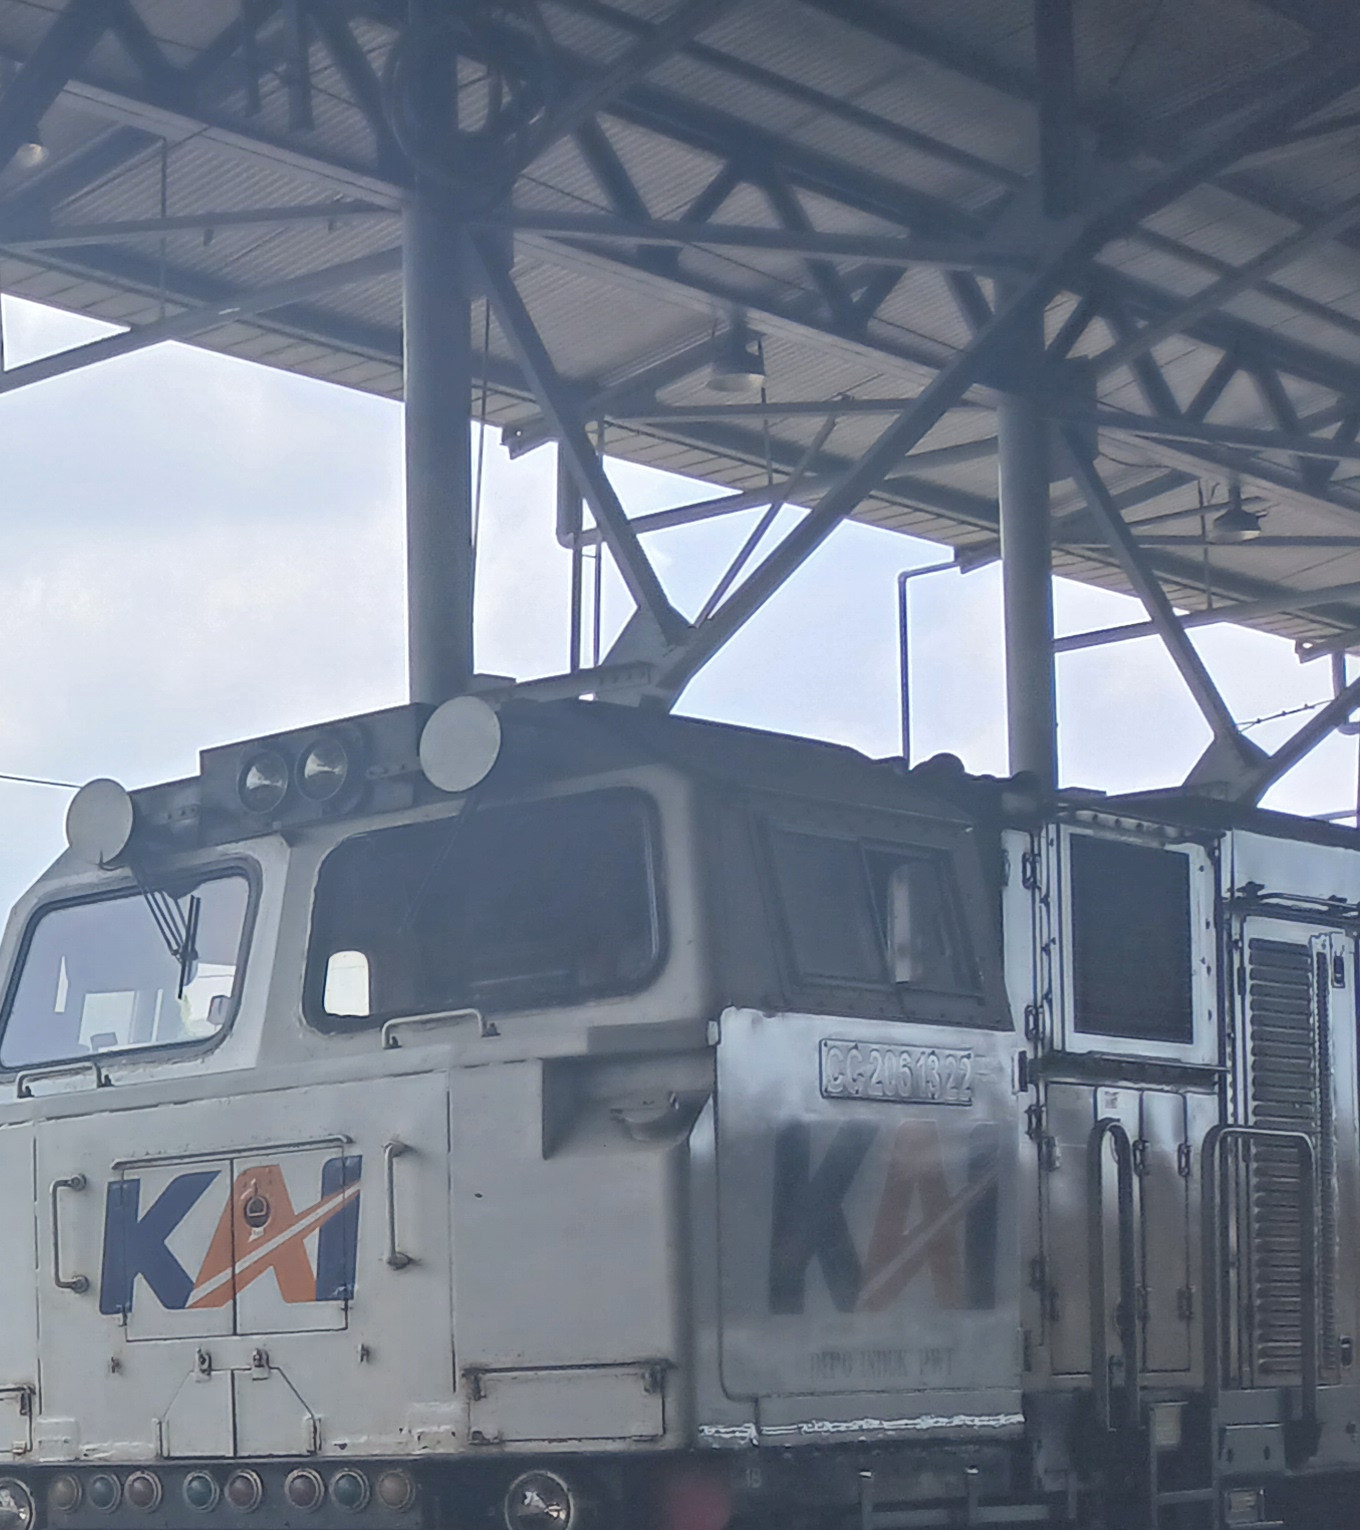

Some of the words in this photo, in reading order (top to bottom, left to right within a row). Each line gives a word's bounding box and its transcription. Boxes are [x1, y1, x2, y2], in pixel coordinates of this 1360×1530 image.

[826, 1047, 864, 1095] CC
[868, 1048, 913, 1097] 206
[916, 1050, 942, 1099] 13
[944, 1053, 973, 1101] 22
[98, 1154, 363, 1315] KAI
[768, 1119, 1001, 1316] KAI
